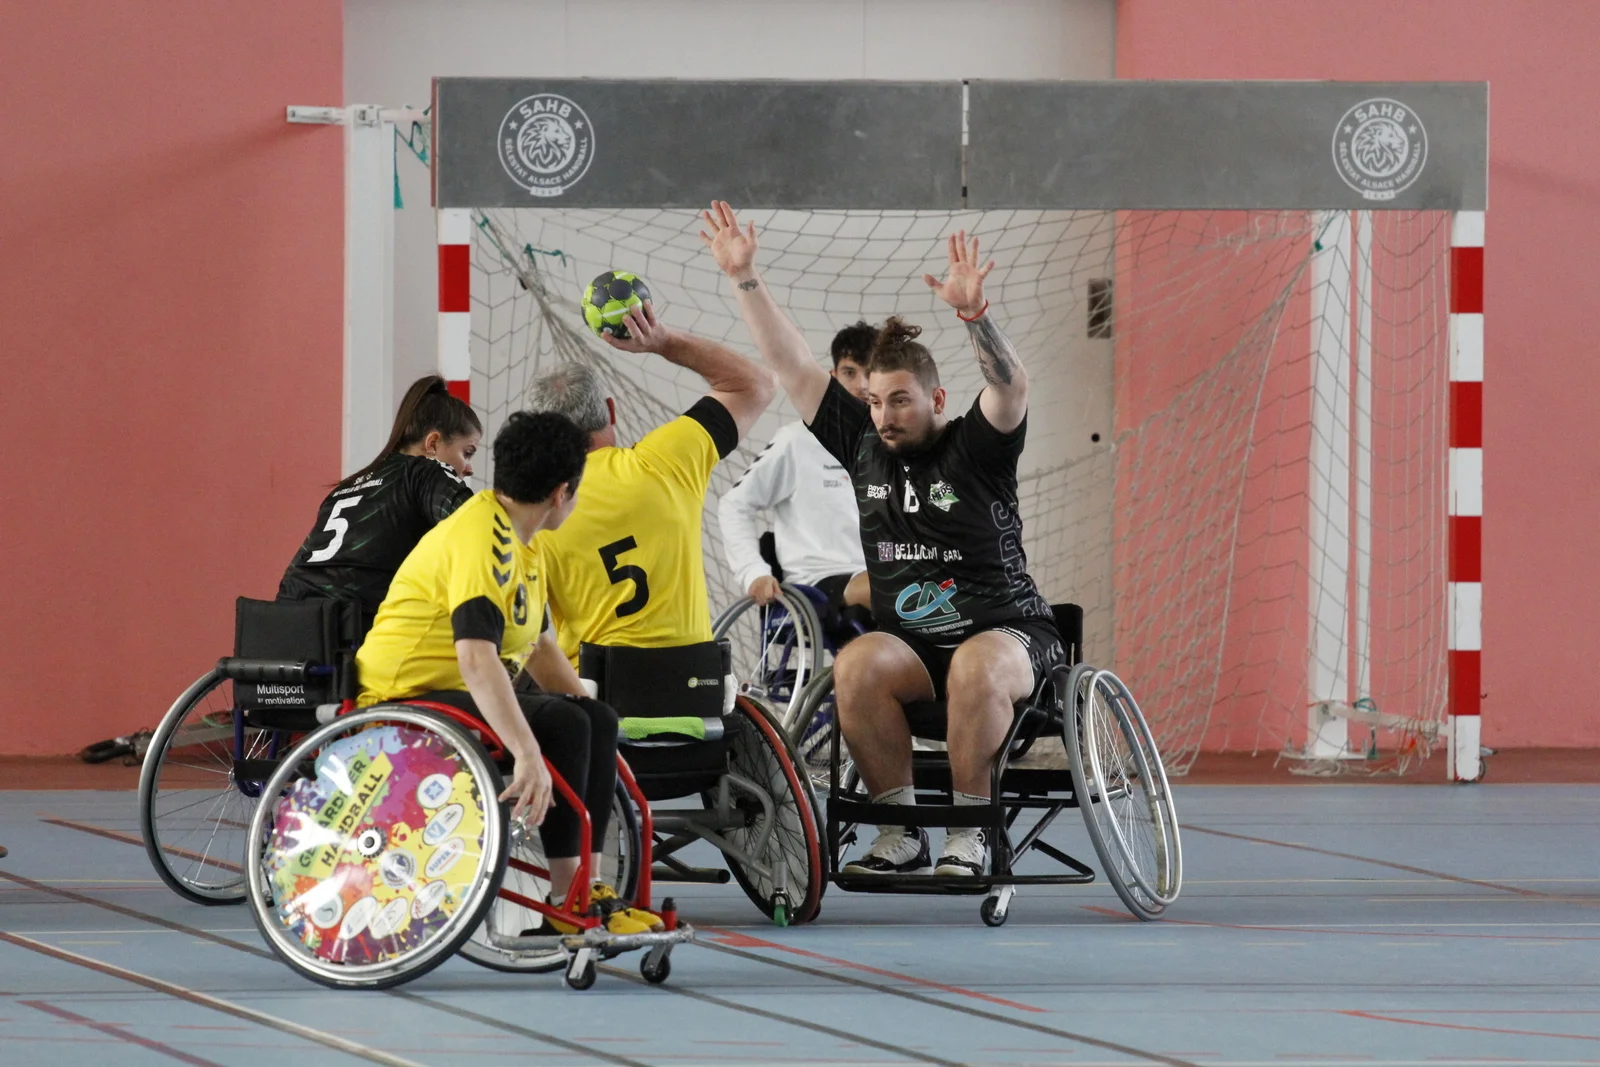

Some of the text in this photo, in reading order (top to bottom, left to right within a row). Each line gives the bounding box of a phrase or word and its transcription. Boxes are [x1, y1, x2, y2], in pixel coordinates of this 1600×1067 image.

[519, 99, 572, 119] SAHB
[1354, 104, 1406, 122] SAHB
[527, 175, 562, 185] ALSACE
[562, 137, 588, 180] HANDBALL
[307, 495, 363, 563] 5
[943, 549, 963, 562] SARL
[598, 535, 649, 618] 5
[256, 684, 305, 696] Multisport
[265, 696, 306, 705] motivation
